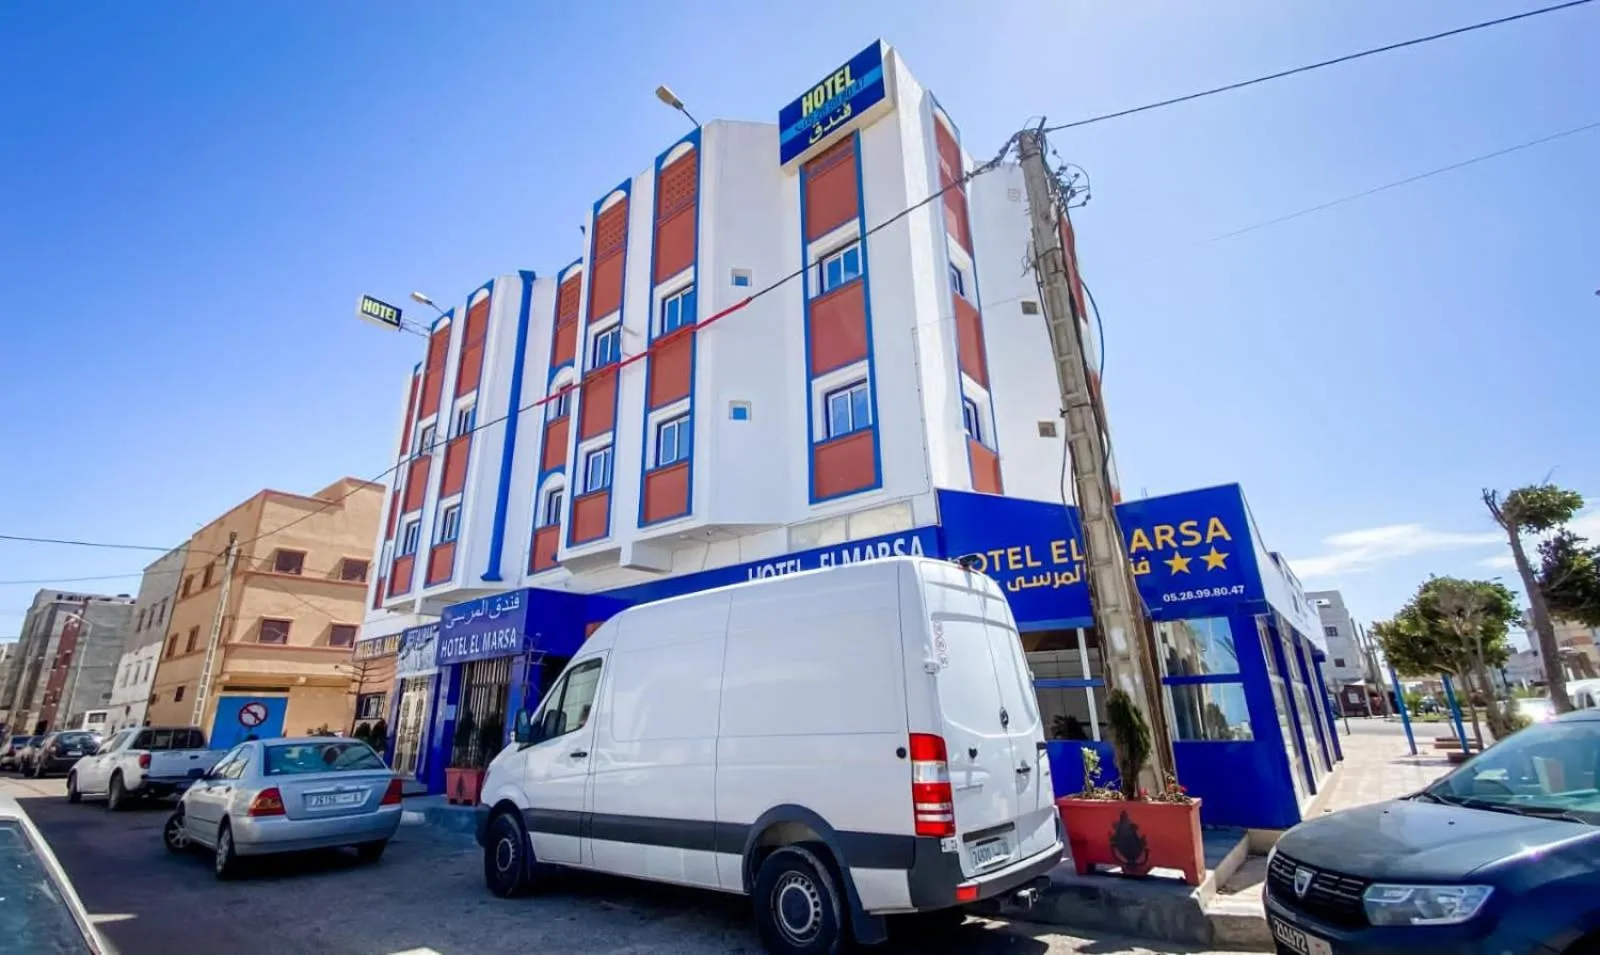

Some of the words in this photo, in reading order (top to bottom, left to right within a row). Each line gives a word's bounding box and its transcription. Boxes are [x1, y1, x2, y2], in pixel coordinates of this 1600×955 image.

[801, 64, 855, 118] HOTEL
[809, 102, 852, 144] فندق
[363, 299, 398, 323] HOTEL
[949, 545, 1041, 574] OTEL
[1051, 538, 1084, 564] EL
[1130, 517, 1232, 553] ARSA
[488, 592, 519, 619] فندق
[1163, 585, 1244, 602] 05.28.99.80.47
[440, 636, 467, 658] HOTEL
[469, 634, 480, 653] EL
[482, 627, 517, 652] MARSA
